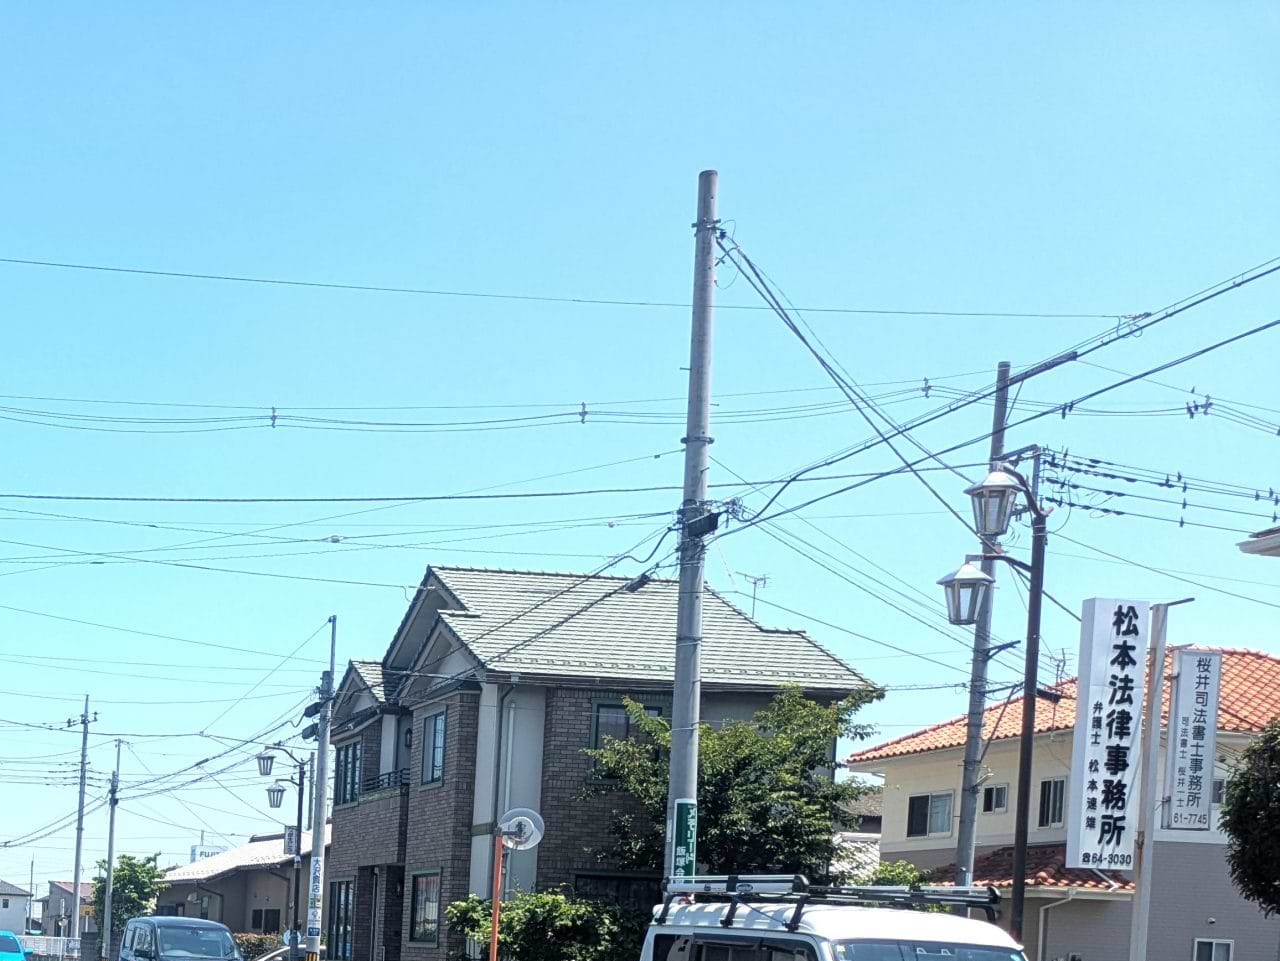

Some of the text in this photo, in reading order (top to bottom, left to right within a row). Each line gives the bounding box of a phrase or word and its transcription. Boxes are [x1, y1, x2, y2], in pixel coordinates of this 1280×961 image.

[1091, 701, 1103, 745] 弁護士
[1097, 604, 1140, 847] 松本法律事務所
[1179, 716, 1188, 759] 司法書士
[1186, 657, 1212, 809] 桜井司法書士事務所
[1173, 813, 1208, 825] 61-7745
[1091, 853, 1132, 865] 64-3030
